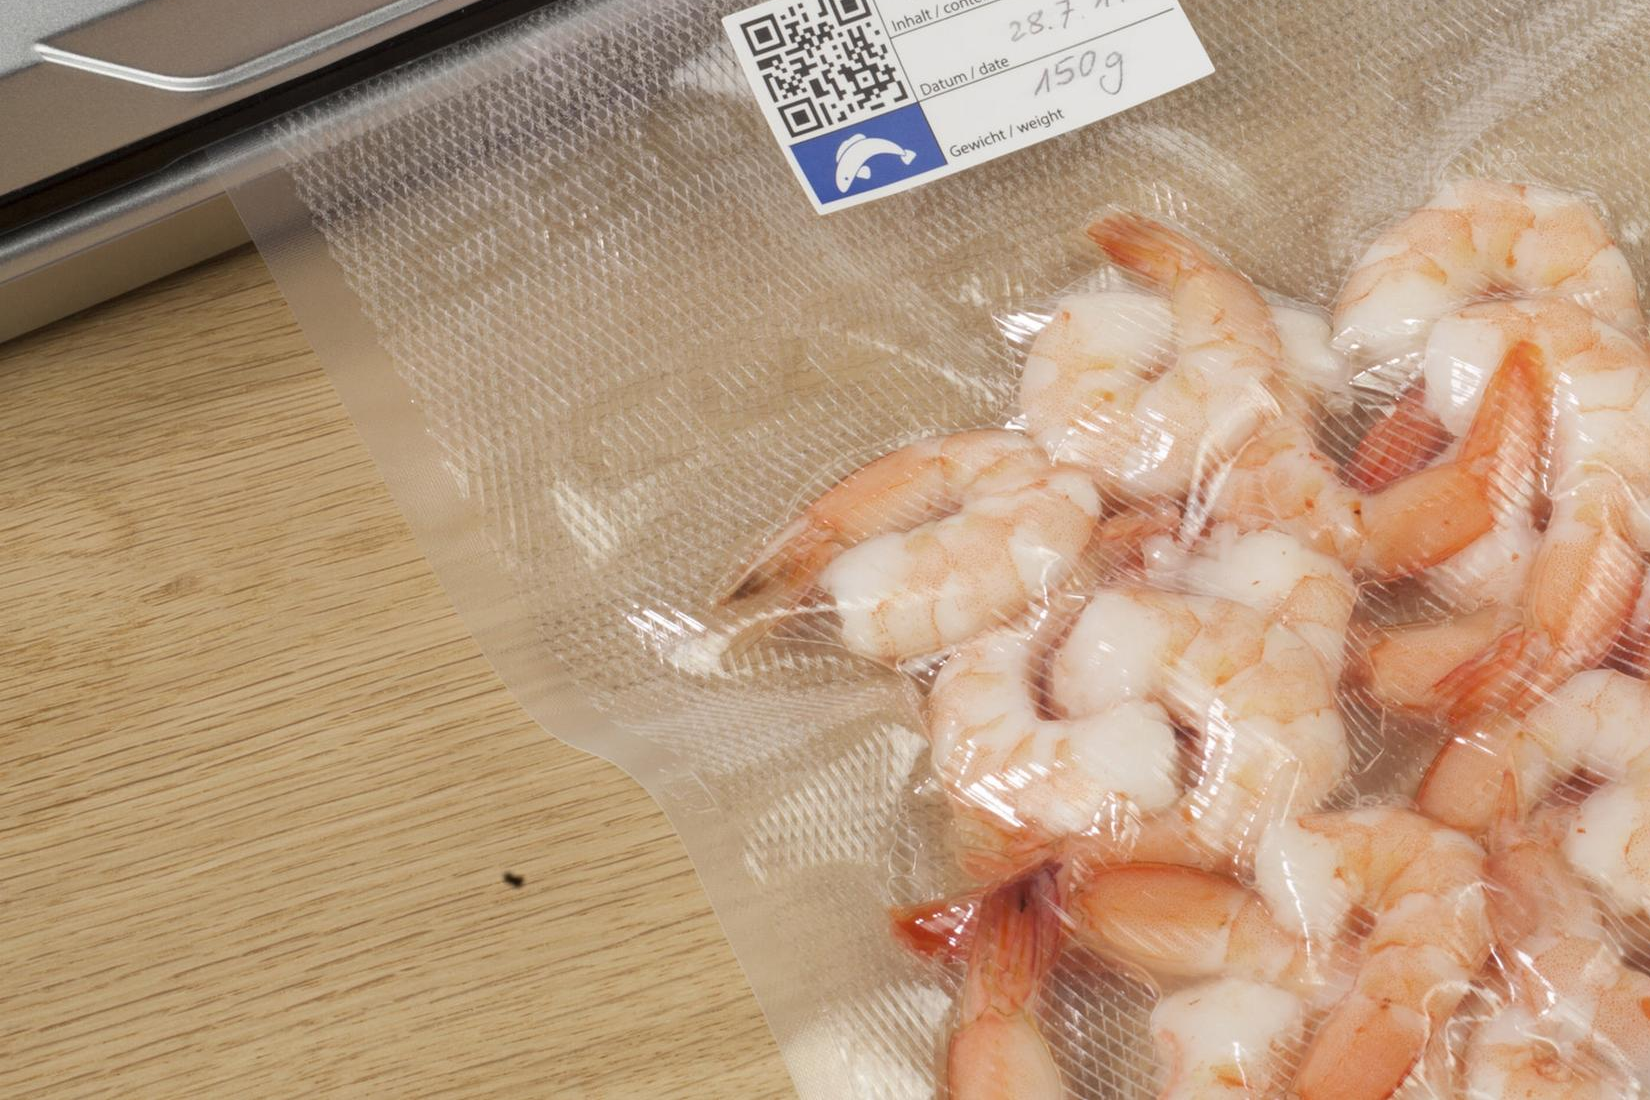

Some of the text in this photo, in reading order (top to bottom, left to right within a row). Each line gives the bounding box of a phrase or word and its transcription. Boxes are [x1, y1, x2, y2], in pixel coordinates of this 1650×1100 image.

[891, 9, 932, 32] Inhalt
[919, 71, 968, 97] Datum
[979, 57, 1010, 76] date
[950, 129, 1007, 158] Gewicht
[1016, 107, 1065, 134] weight
